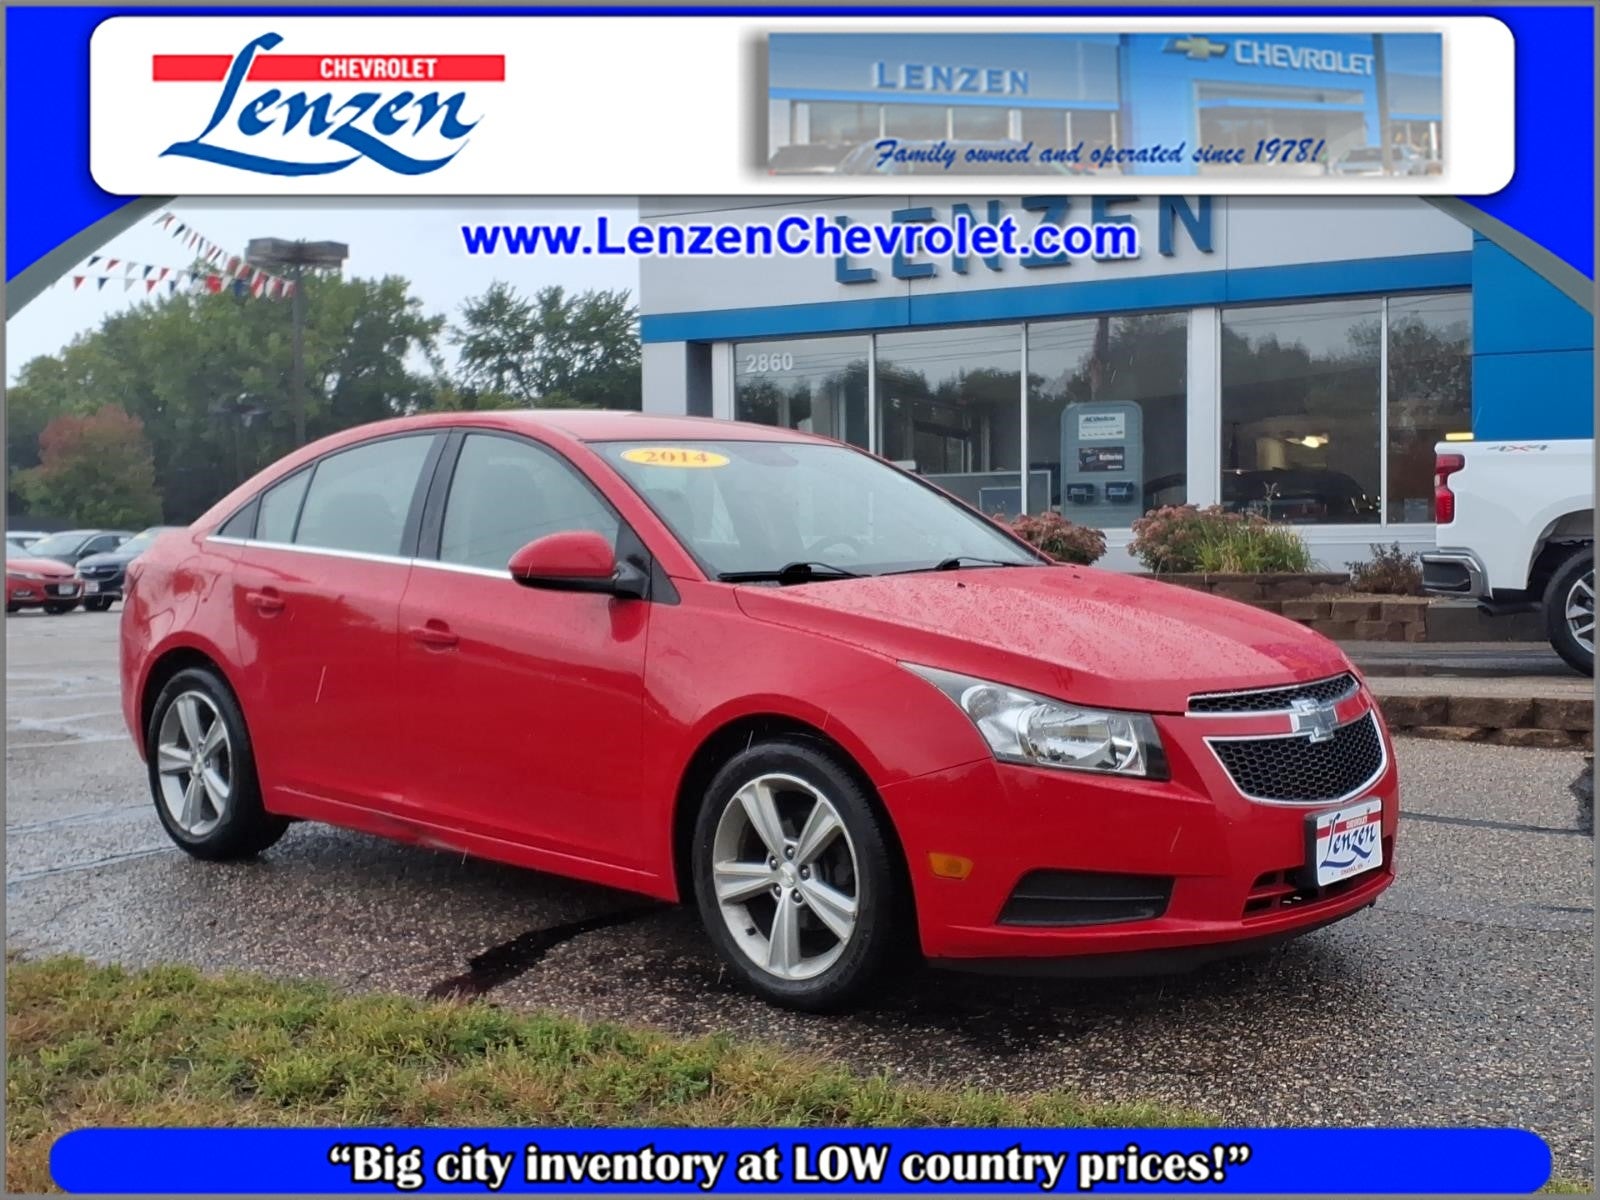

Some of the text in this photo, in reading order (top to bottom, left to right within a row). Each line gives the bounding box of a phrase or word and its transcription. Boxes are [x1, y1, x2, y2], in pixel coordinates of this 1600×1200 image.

[745, 352, 793, 373] 2860
[642, 451, 708, 463] 2014
[1319, 812, 1377, 869] Lenzen
